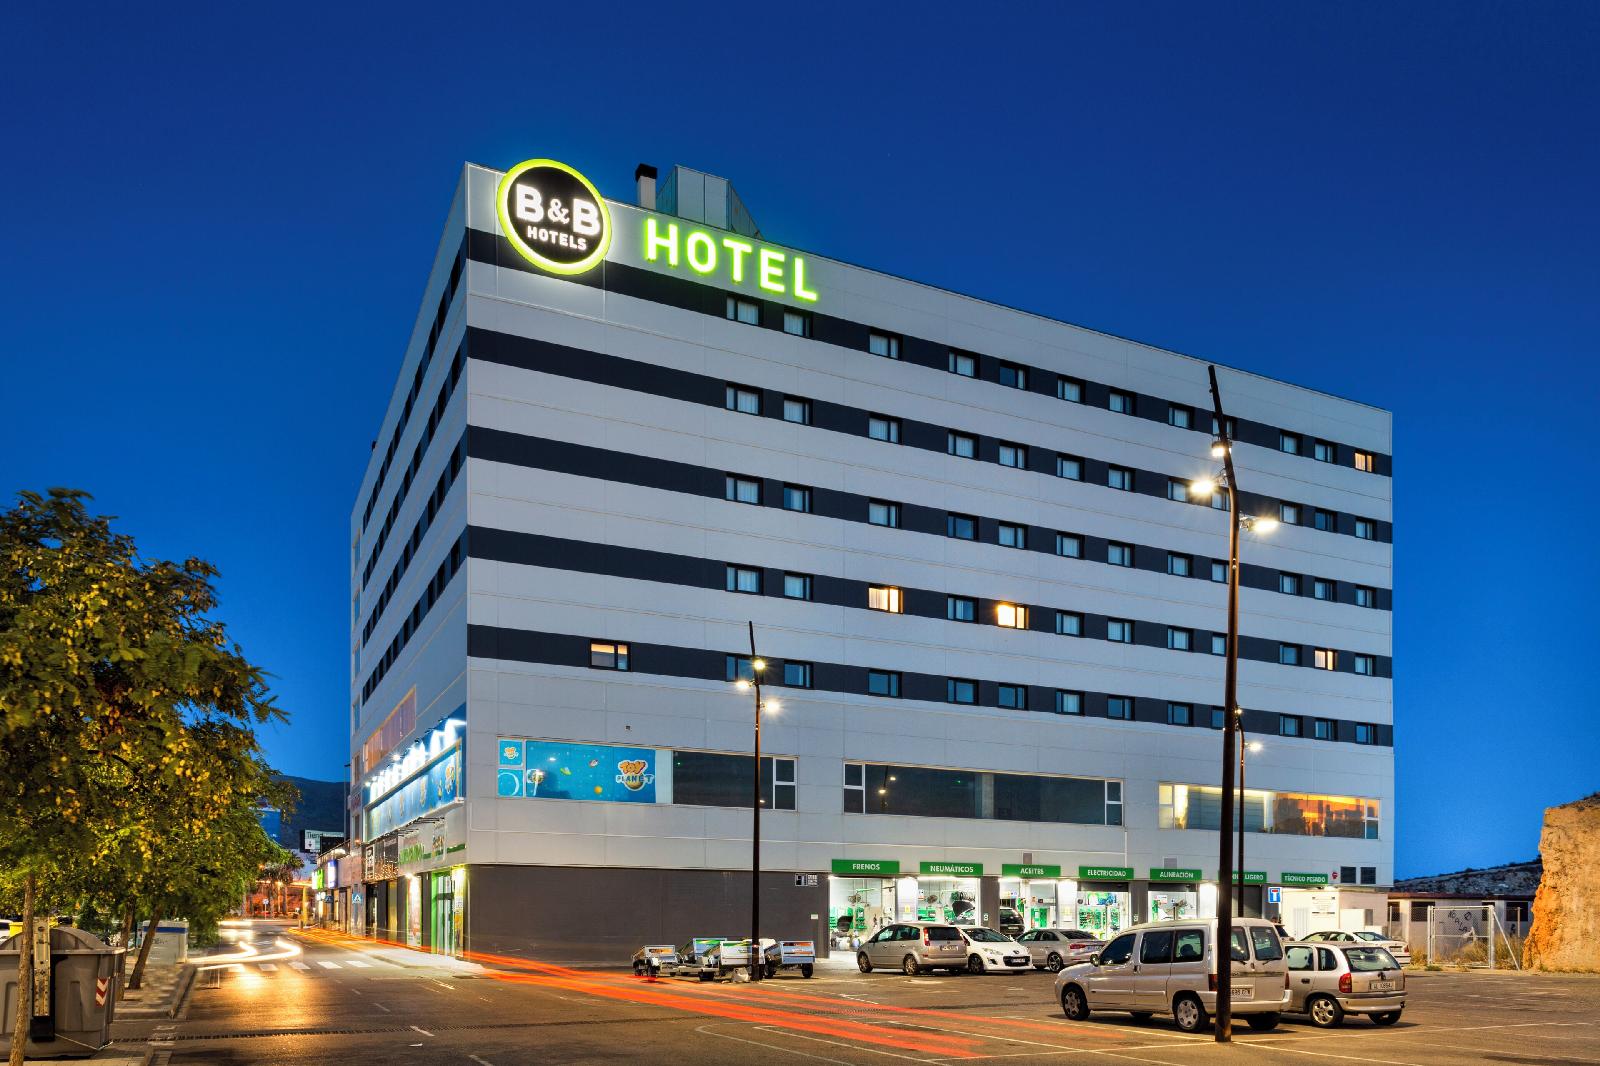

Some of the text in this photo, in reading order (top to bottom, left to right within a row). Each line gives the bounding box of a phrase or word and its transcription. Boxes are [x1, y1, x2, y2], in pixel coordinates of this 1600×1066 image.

[515, 183, 601, 236] B&B
[527, 225, 587, 251] HOTELS
[645, 217, 818, 302] HOTEL
[619, 761, 646, 775] TOY
[616, 775, 654, 783] PLANET
[852, 863, 881, 871] FRENOS
[930, 864, 974, 873] NEUMÁTICOS
[1020, 867, 1044, 875] ACEITES
[1087, 869, 1127, 877] ELECTRICIDAD
